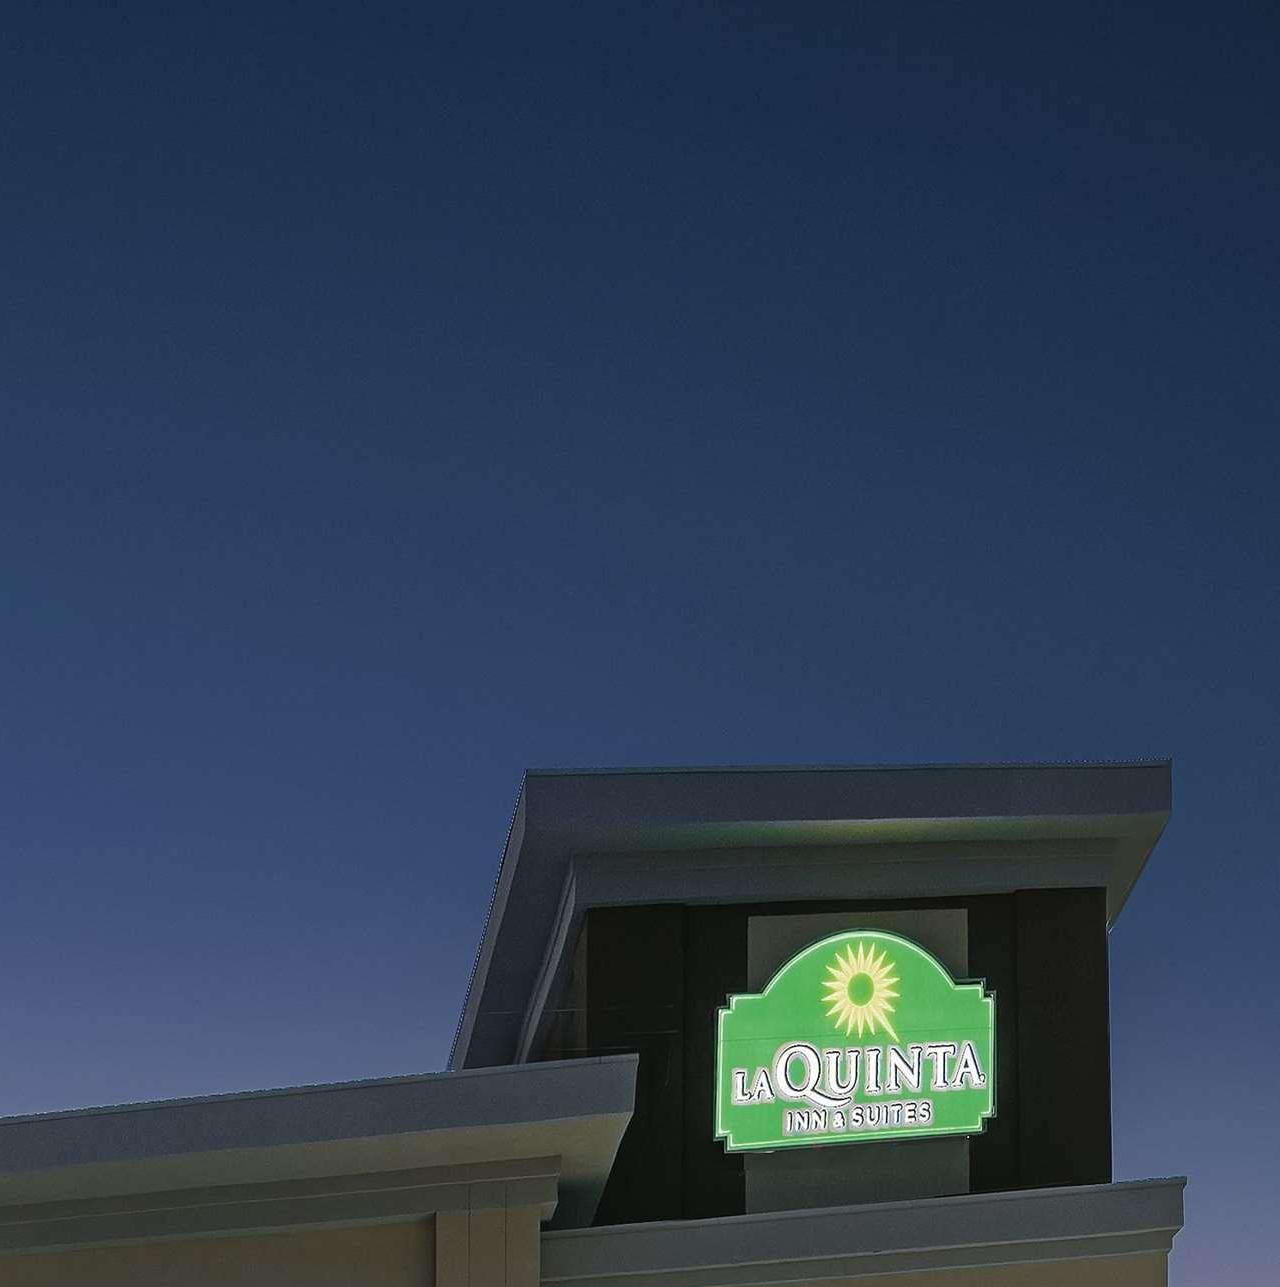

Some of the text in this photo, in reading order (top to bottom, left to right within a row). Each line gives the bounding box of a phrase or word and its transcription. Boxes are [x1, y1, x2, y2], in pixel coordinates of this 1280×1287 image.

[734, 1042, 985, 1108] LA QUINTA
[785, 1101, 931, 1133] INN & SUITES
